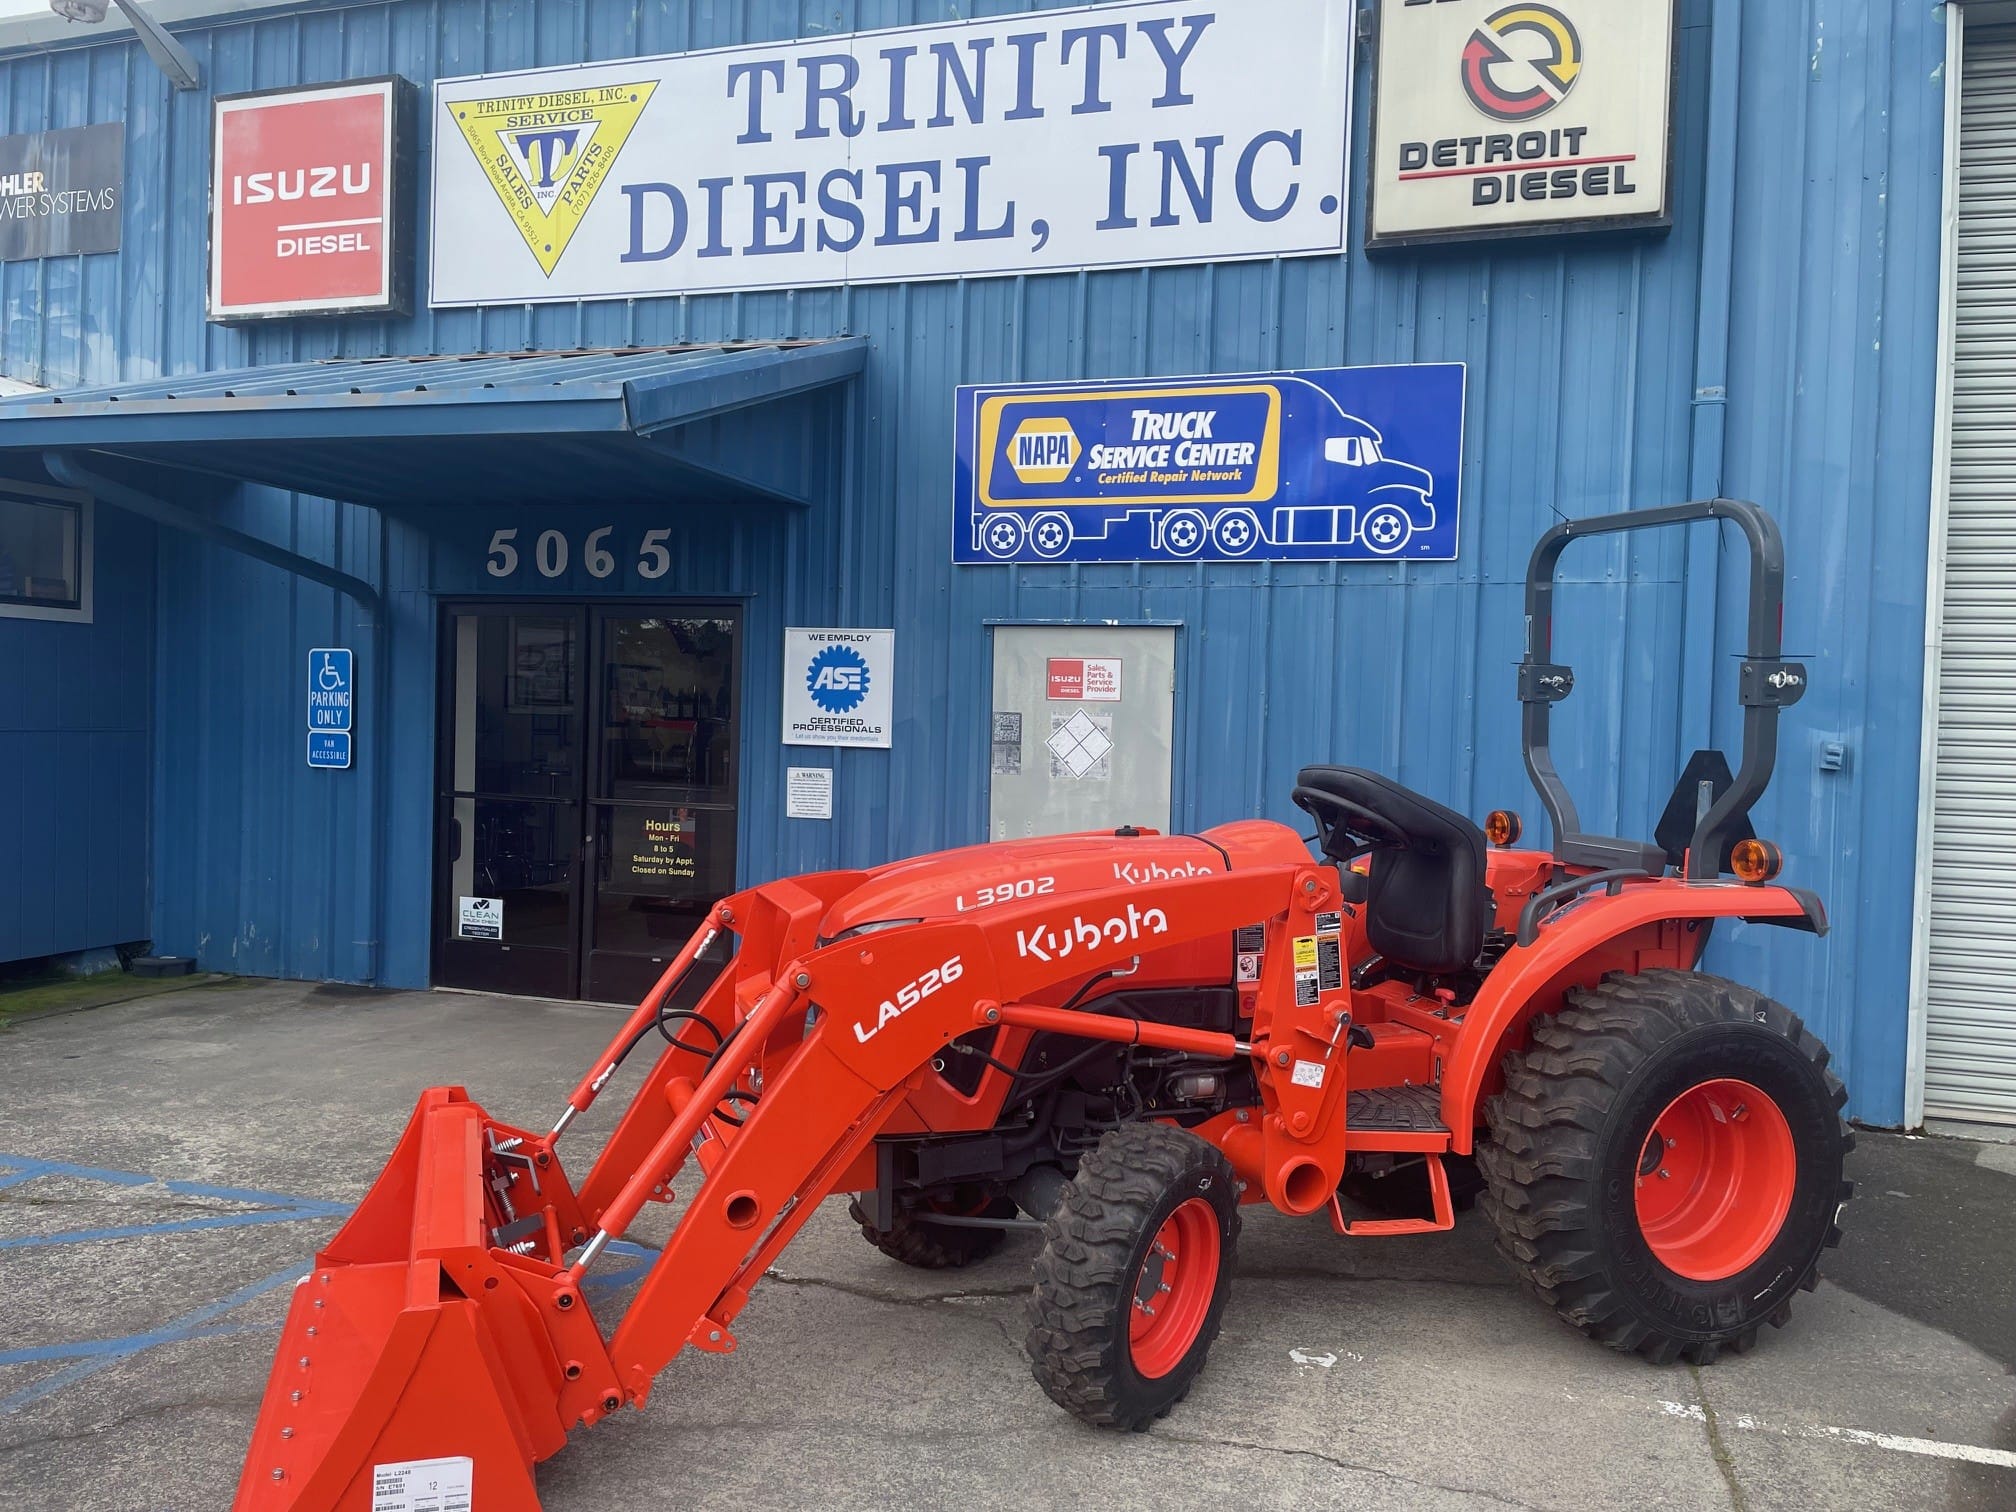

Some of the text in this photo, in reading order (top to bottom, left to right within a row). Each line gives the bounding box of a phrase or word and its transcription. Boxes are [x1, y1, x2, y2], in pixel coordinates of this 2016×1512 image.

[727, 13, 1216, 145] TRINITY
[477, 87, 627, 114] TRINITY DIESEL, INC.
[507, 109, 593, 127] SERVICE
[1399, 126, 1587, 171] DETROIT
[0, 172, 48, 197] HLER.
[234, 163, 370, 205] ISUZU
[466, 125, 481, 146] 5065
[478, 145, 493, 165] Boyd
[489, 164, 504, 185] Road
[516, 209, 526, 222] CA
[523, 221, 541, 246] 95521
[496, 154, 533, 210] SALES
[562, 143, 603, 206] PARTS
[571, 145, 615, 216] (707) 826-8400
[1472, 165, 1636, 207] DIESEL
[40, 187, 114, 216] SYSTEMS
[537, 190, 557, 199] INC.
[620, 128, 1338, 263] DIESEL, INC.
[277, 233, 370, 257] DIESEL
[1131, 409, 1217, 441] TRUCK
[1019, 434, 1070, 467] NAPA
[1087, 441, 1256, 470] SERVICE CENTER
[1098, 468, 1242, 485] Certified Repair Network
[486, 525, 671, 579] 5065
[827, 634, 871, 642] EMPLOY
[813, 666, 861, 690] ASE
[1051, 675, 1081, 683] ISUZU
[1087, 664, 1107, 672] Sales,
[311, 691, 349, 707] PARKING
[1087, 685, 1117, 693] Provider
[317, 710, 342, 725] ONLY
[793, 723, 882, 734] PROFESSIONALS
[810, 717, 864, 726] CERTIFIED
[311, 750, 346, 760] ACCESSIBLE
[324, 739, 335, 748] VAN
[645, 819, 681, 832] Hours
[648, 833, 664, 841] Mon
[670, 834, 680, 842] Fri
[631, 865, 656, 874] Closed
[668, 868, 695, 878] Sunday
[633, 854, 695, 866] Saturday by Appt.
[1112, 861, 1213, 884] Kubota
[956, 876, 1055, 913] L3902
[463, 909, 499, 919] CLEAN
[1016, 903, 1169, 962] Kubota
[853, 954, 964, 1044] LA526
[429, 1481, 438, 1490] 12
